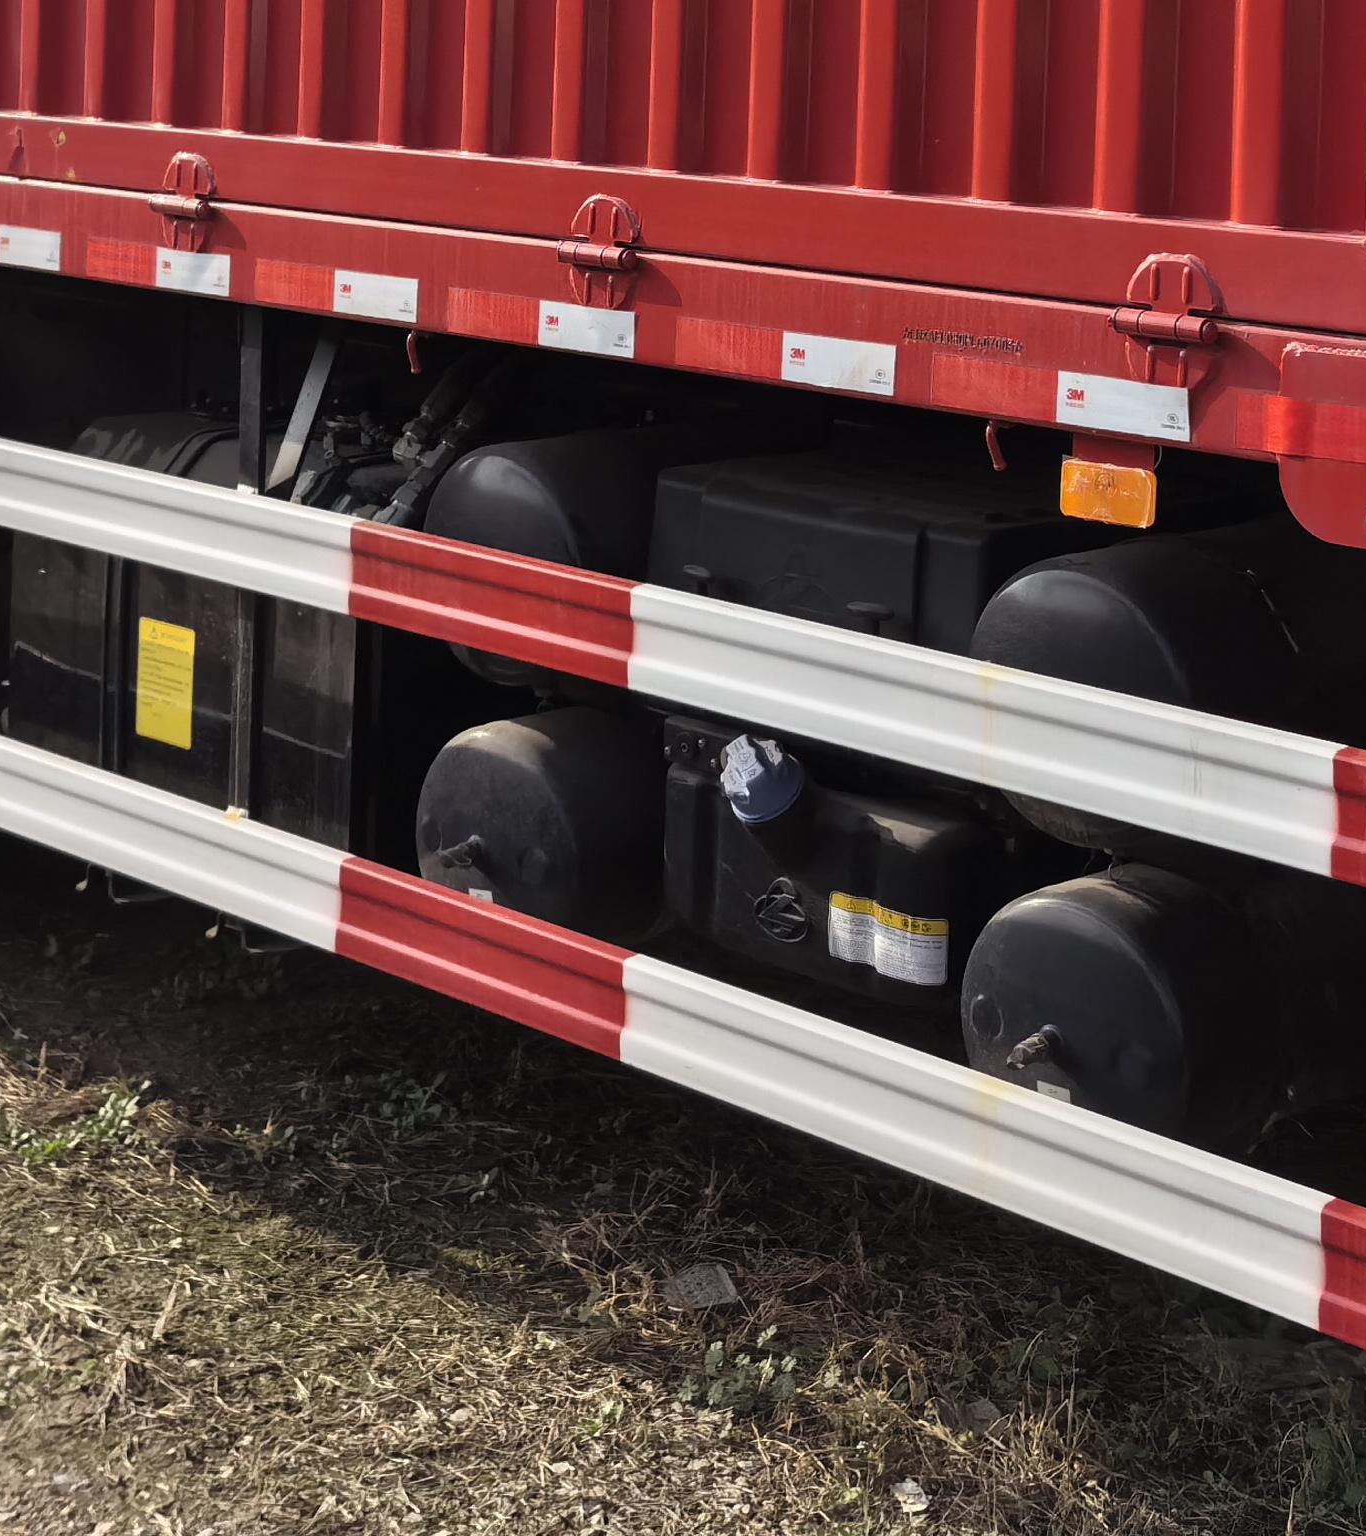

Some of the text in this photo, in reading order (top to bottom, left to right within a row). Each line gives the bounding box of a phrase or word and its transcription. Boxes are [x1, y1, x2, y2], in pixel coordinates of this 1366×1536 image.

[546, 315, 559, 327] 3M
[790, 347, 806, 360] 3M
[1066, 388, 1085, 402] 3M
